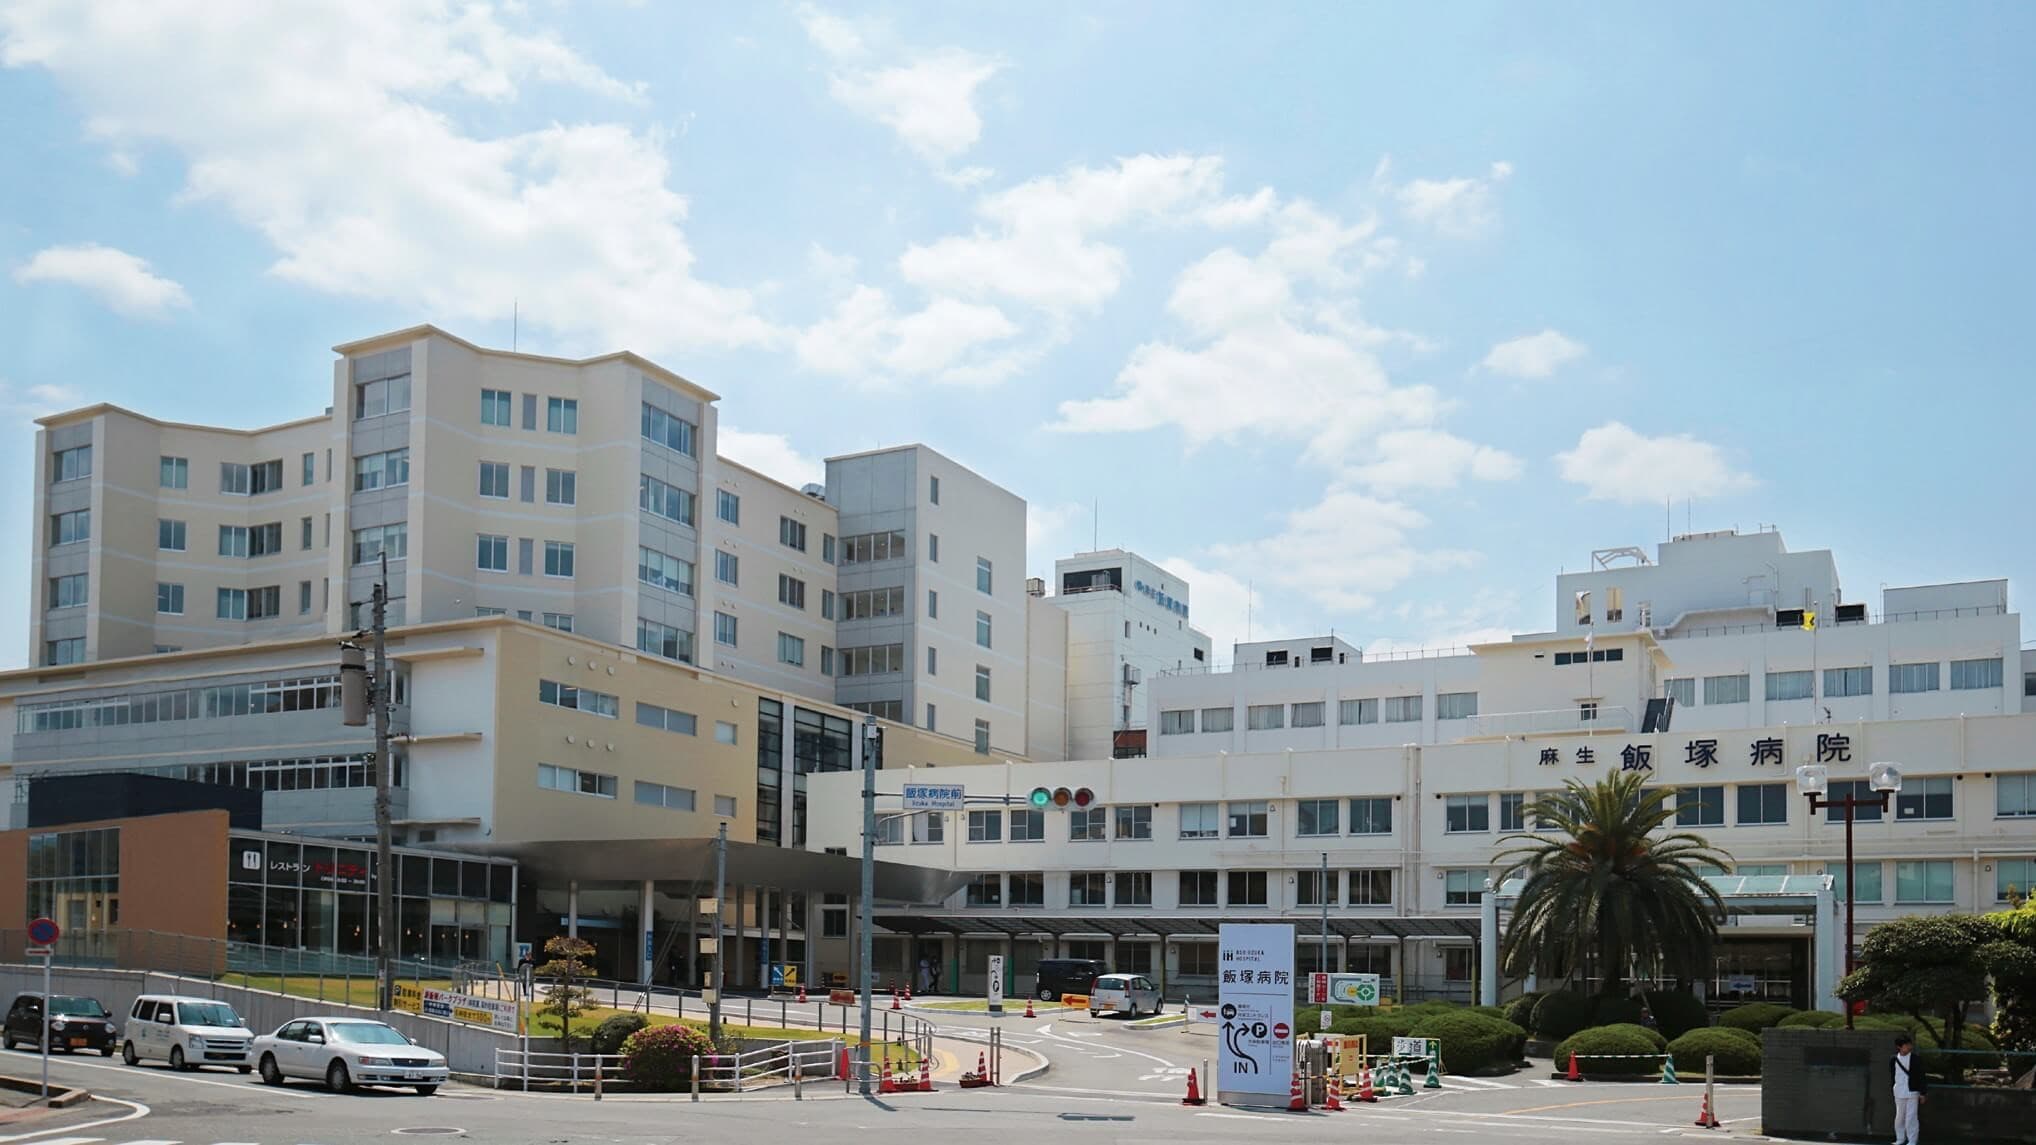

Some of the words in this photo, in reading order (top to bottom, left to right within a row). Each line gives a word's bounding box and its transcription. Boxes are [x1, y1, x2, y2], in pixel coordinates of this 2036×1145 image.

[1620, 733, 1852, 771] 飯塚病院
[906, 788, 962, 799] 飯塚病院前
[270, 861, 311, 872] レストラン
[1223, 970, 1289, 985] 飯塚病院
[1234, 1062, 1248, 1073] IN
